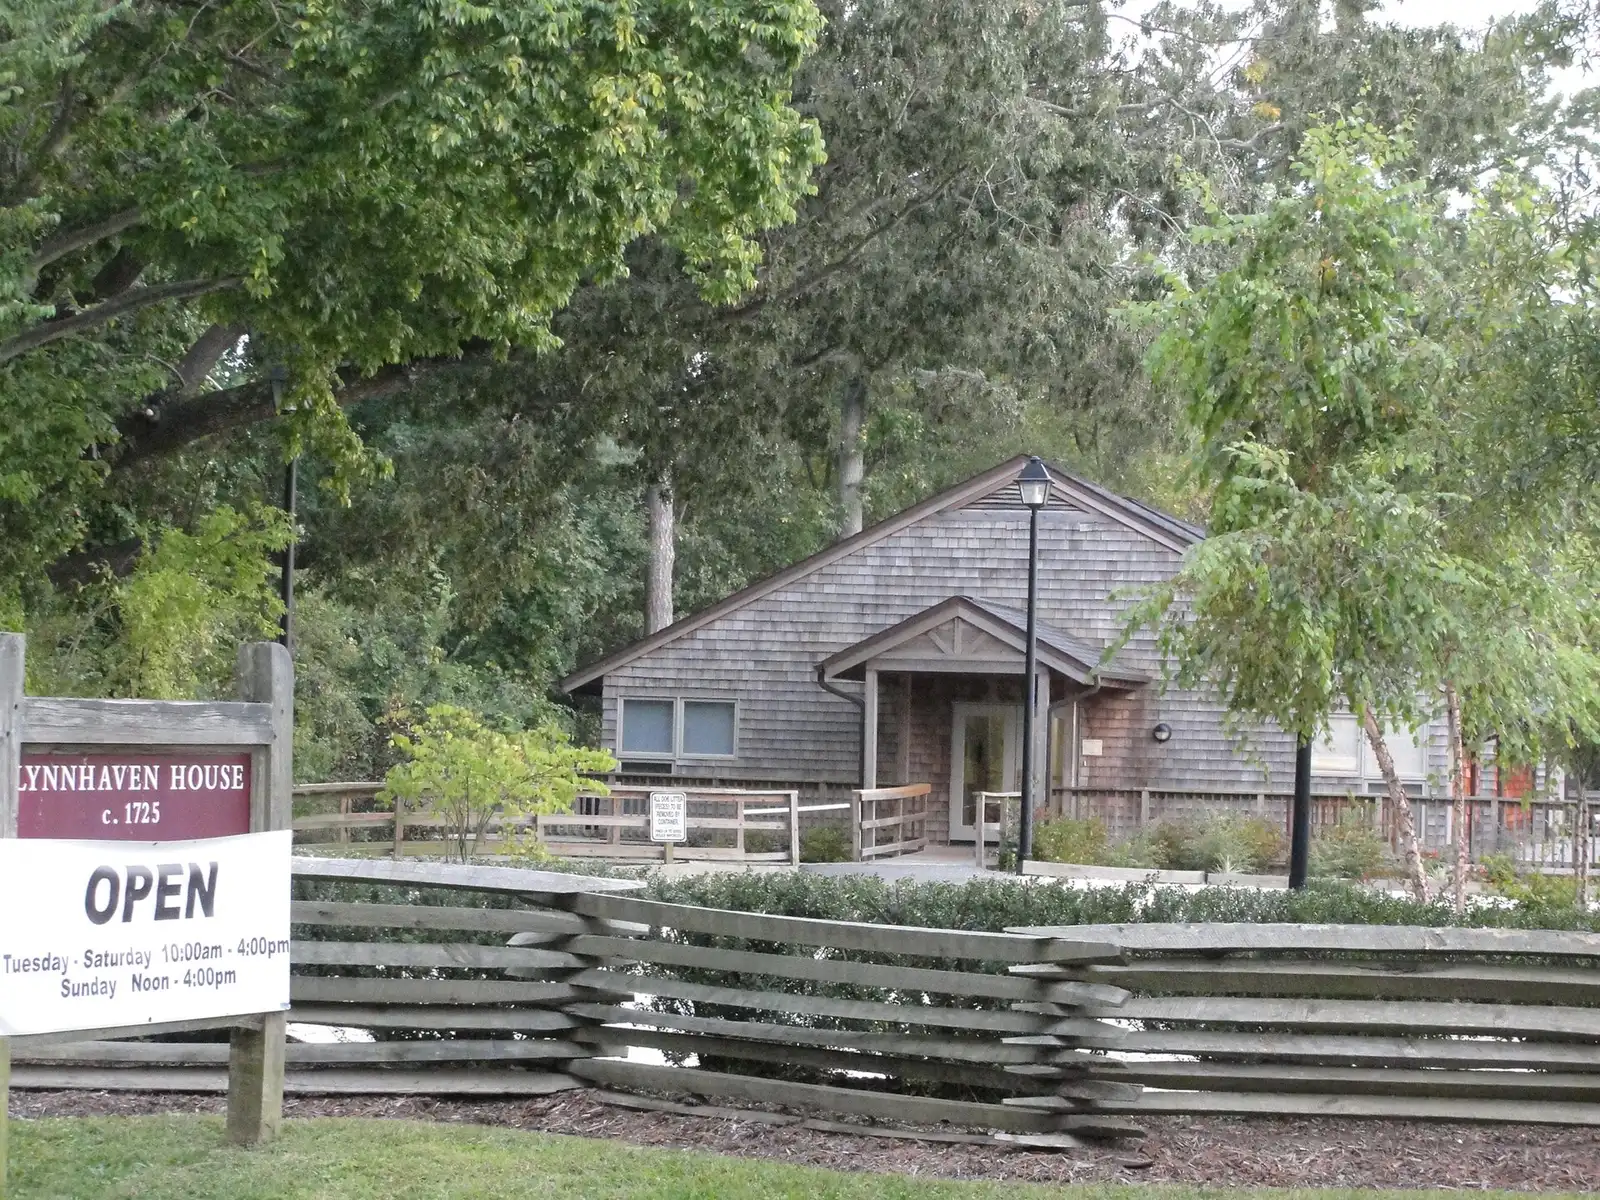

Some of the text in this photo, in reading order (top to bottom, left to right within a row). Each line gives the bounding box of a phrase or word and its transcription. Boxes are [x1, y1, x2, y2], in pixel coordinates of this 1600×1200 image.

[17, 764, 244, 792] LYNNHAVEN HOUSE
[102, 801, 160, 824] c. 1725
[85, 861, 219, 925] OPEN
[3, 952, 69, 975] Tuesday
[83, 947, 152, 970] Saturday
[162, 942, 223, 963] 10:00am
[237, 937, 290, 959] 4:00pm
[61, 976, 117, 1000] Sunday
[132, 973, 169, 992] Noon
[183, 967, 237, 990] 4:00pm
